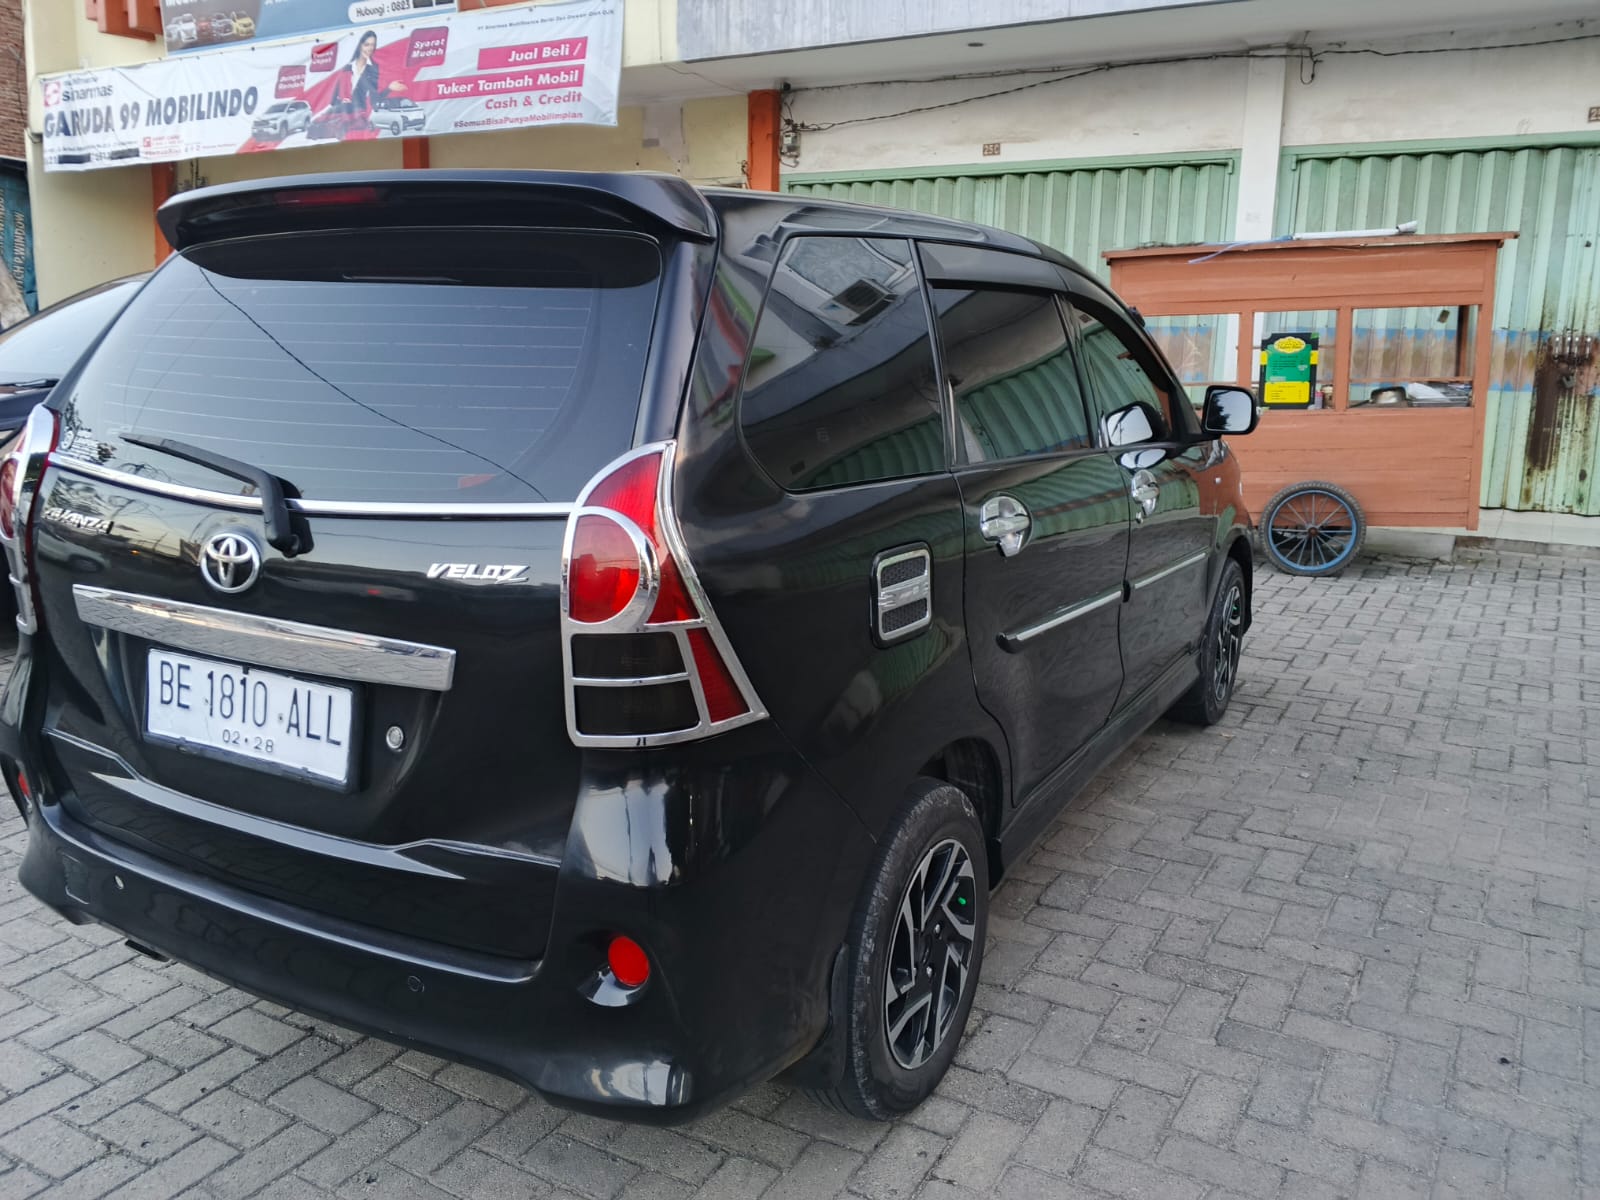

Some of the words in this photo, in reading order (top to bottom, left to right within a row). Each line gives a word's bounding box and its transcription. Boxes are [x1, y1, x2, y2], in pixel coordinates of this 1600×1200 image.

[411, 48, 444, 59] Mudah
[413, 38, 446, 51] Syarat
[508, 47, 538, 63] Jual
[542, 43, 569, 58] Beli
[437, 78, 474, 95] Tuker
[478, 75, 533, 92] Tambah
[537, 70, 579, 85] Mobil
[485, 98, 518, 110] Cash
[523, 95, 533, 106] &
[538, 91, 582, 105] Credit
[43, 105, 115, 138] GARUDA
[119, 101, 140, 130] 99
[145, 86, 258, 127] MOBILINDO
[426, 563, 530, 585] VELOZ
[160, 660, 191, 710] BE
[207, 670, 268, 728] 1810
[286, 687, 342, 746] ALL
